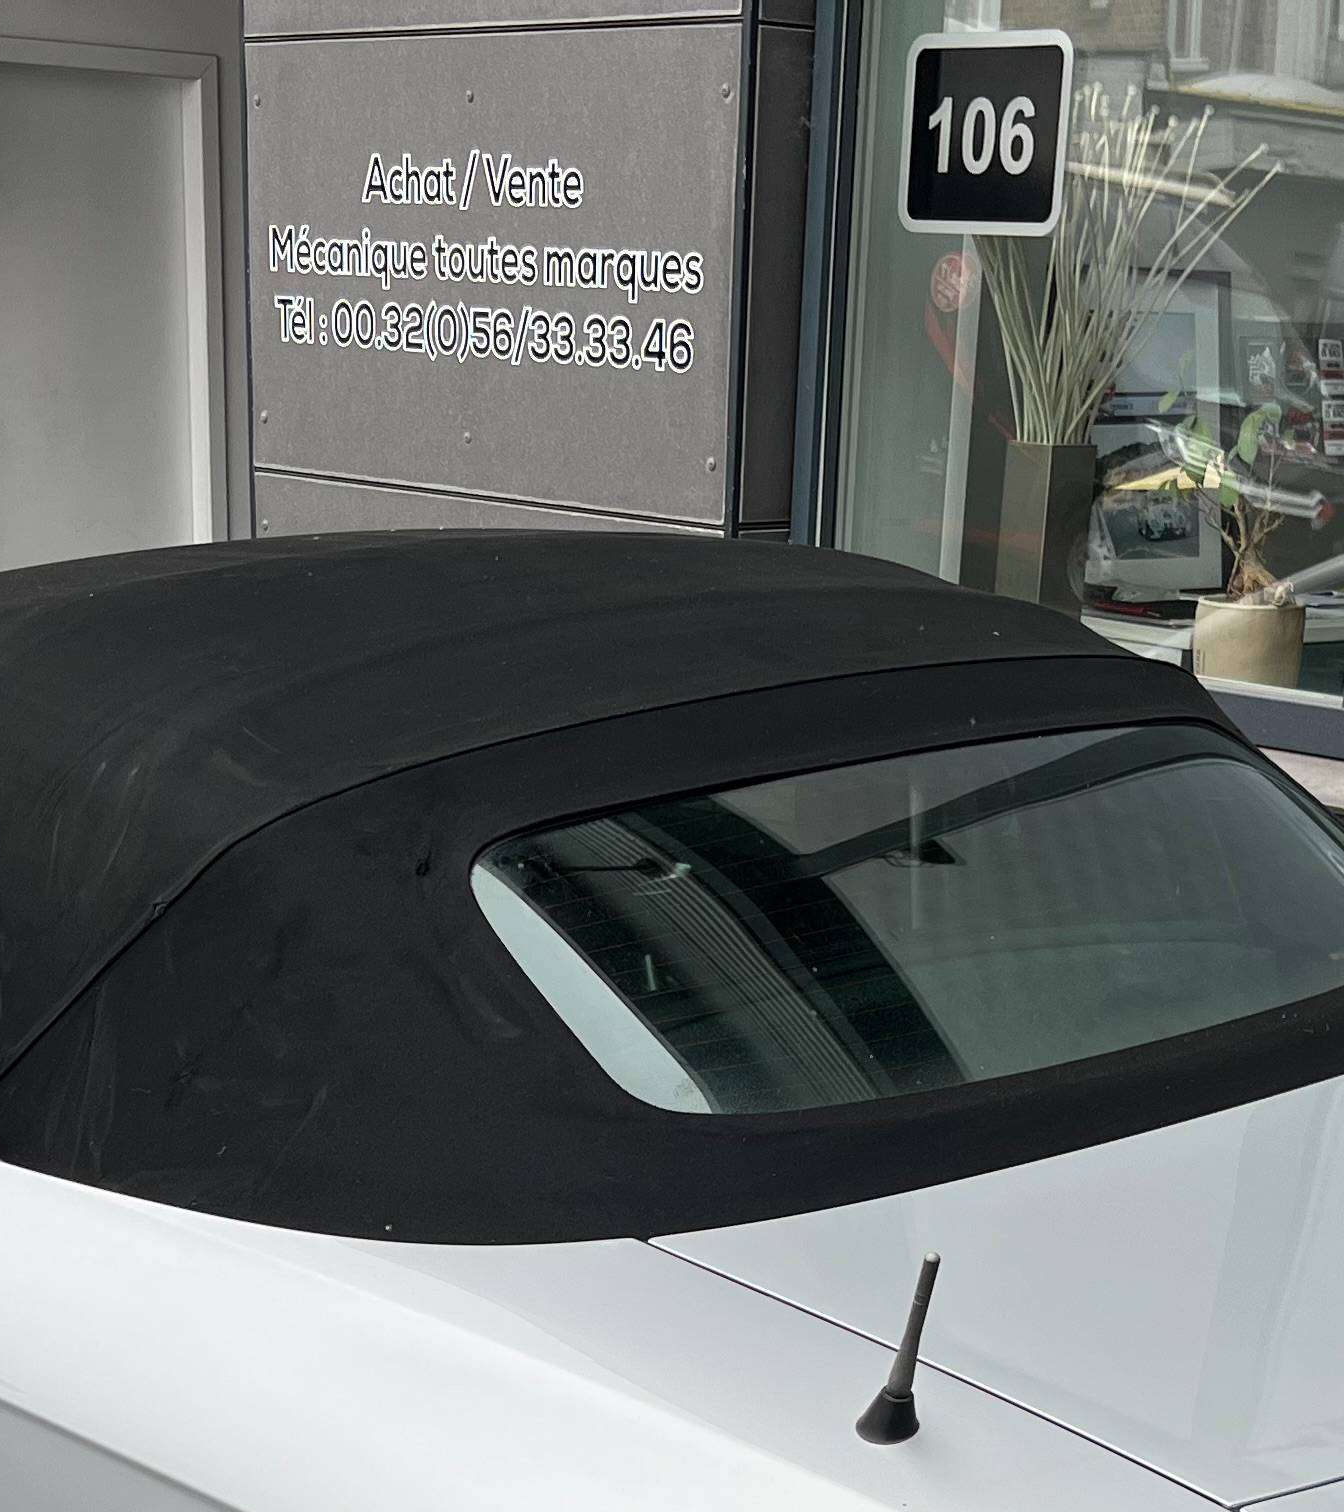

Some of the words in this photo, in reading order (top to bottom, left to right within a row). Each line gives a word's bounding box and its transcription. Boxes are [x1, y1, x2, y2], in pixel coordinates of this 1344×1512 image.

[928, 96, 1035, 175] 106
[362, 153, 456, 204] Achat
[482, 153, 583, 209] Vente
[269, 226, 427, 290] Mécanique
[432, 237, 537, 285] toutes
[544, 248, 703, 303] marques
[333, 300, 694, 373] 00.32(0)56/33.33.46
